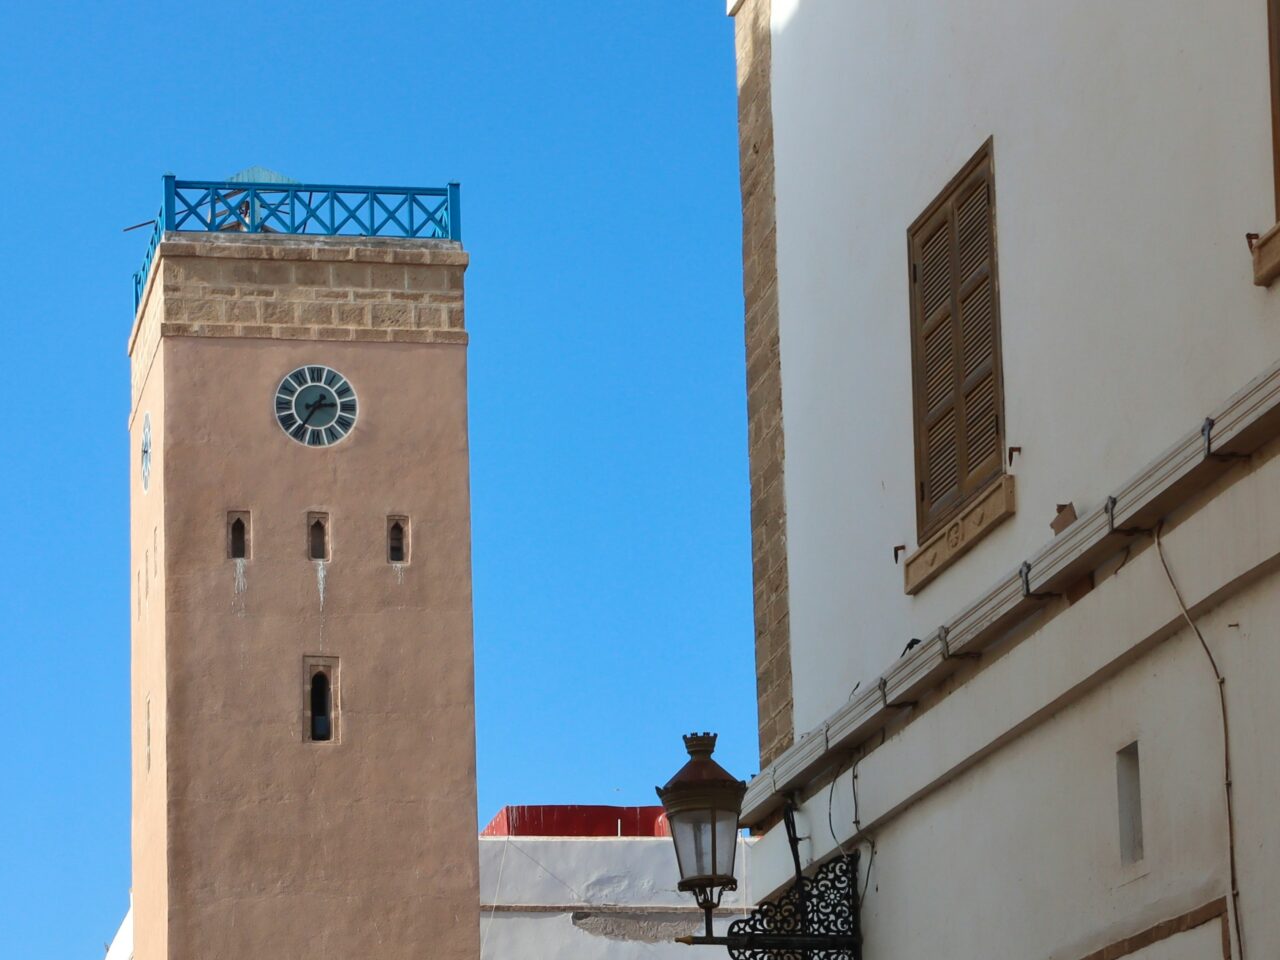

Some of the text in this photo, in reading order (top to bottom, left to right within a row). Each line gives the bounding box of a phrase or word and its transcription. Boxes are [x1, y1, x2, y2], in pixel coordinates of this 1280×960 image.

[295, 372, 308, 385] XI
[311, 368, 322, 382] XII
[328, 374, 336, 386] I
[337, 386, 351, 397] II
[341, 403, 356, 411] III
[328, 428, 338, 441] V
